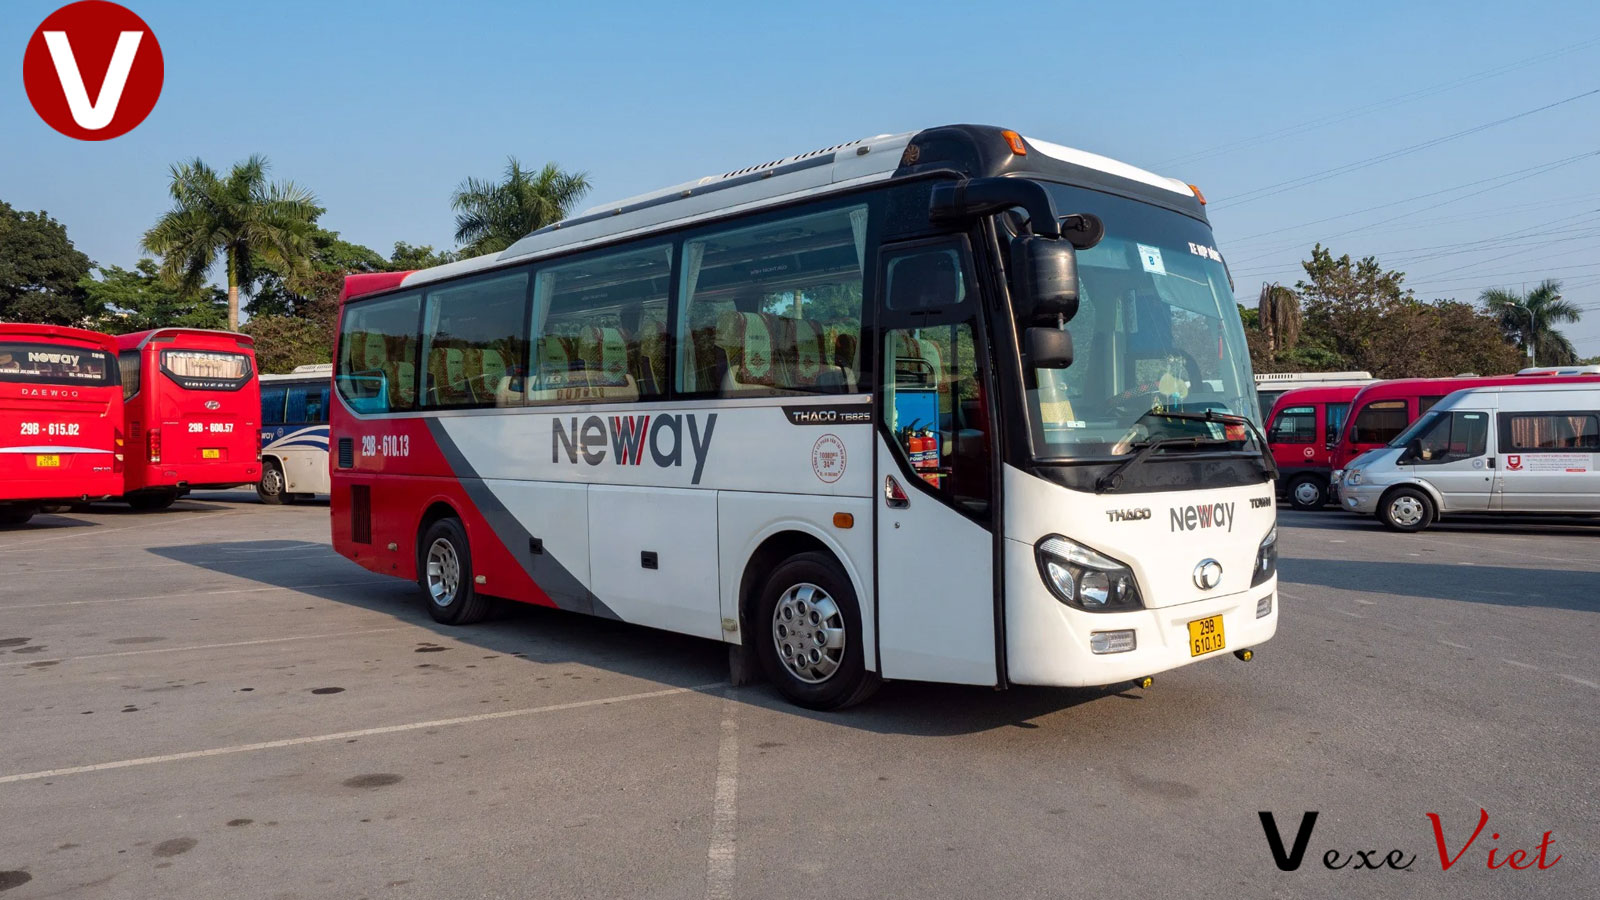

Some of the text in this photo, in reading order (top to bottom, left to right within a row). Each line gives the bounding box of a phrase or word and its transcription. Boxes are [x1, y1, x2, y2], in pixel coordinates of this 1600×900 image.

[21, 389, 79, 397] DAEWOO
[793, 411, 837, 421] THACO
[20, 422, 40, 435] 29B
[48, 423, 80, 436] 615.02
[188, 422, 203, 433] 29B
[362, 435, 376, 457] 29B
[382, 435, 409, 457] 610.13
[1106, 508, 1152, 522] THACO
[1199, 619, 1215, 635] 29B
[1194, 633, 1222, 653] 610.13
